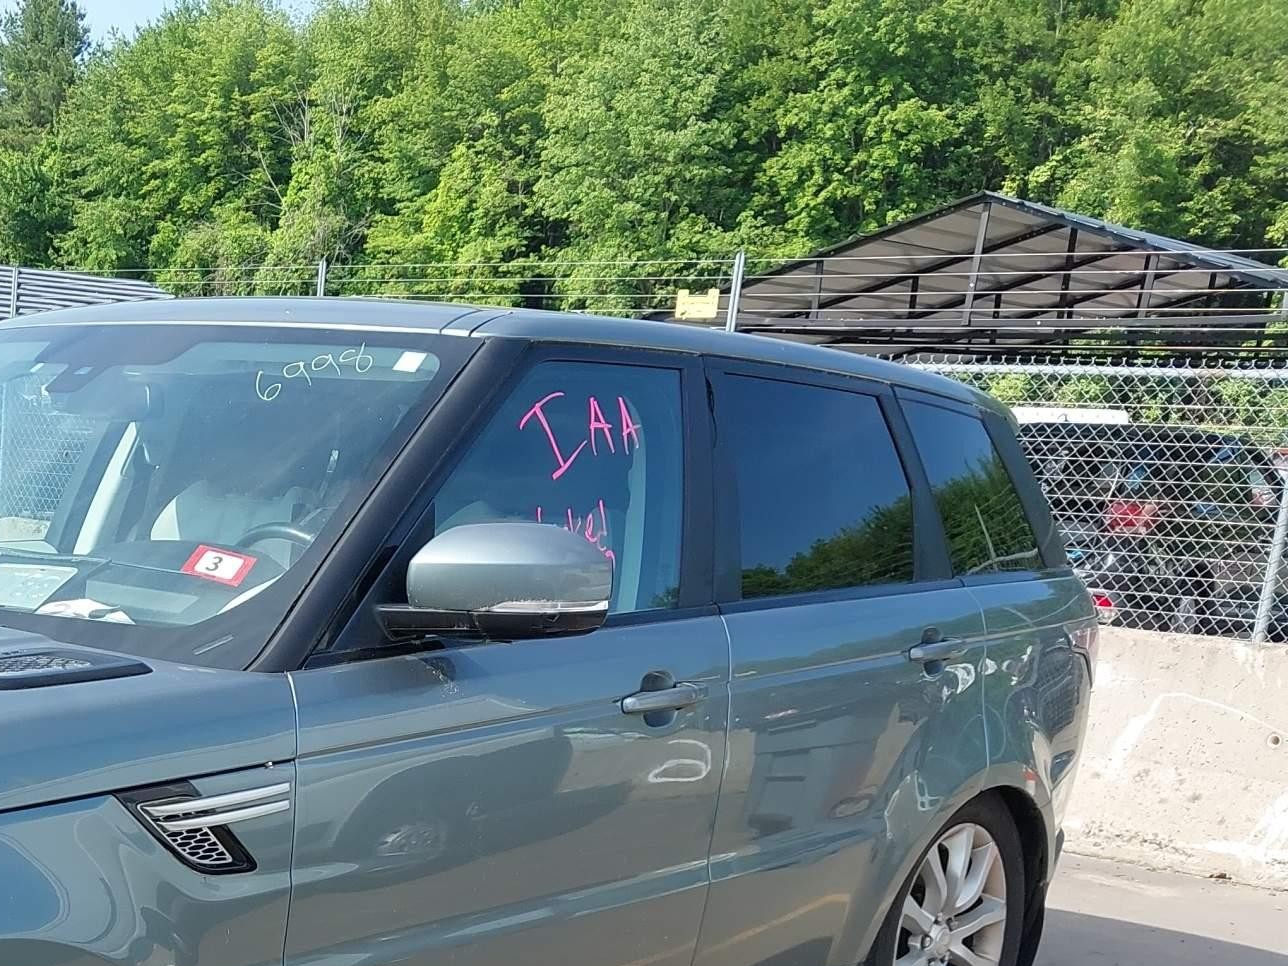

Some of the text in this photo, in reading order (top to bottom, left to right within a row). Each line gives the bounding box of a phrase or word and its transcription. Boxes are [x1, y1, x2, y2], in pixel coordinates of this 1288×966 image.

[255, 342, 373, 401] 6998
[519, 391, 642, 480] IAA
[205, 556, 223, 571] 3
